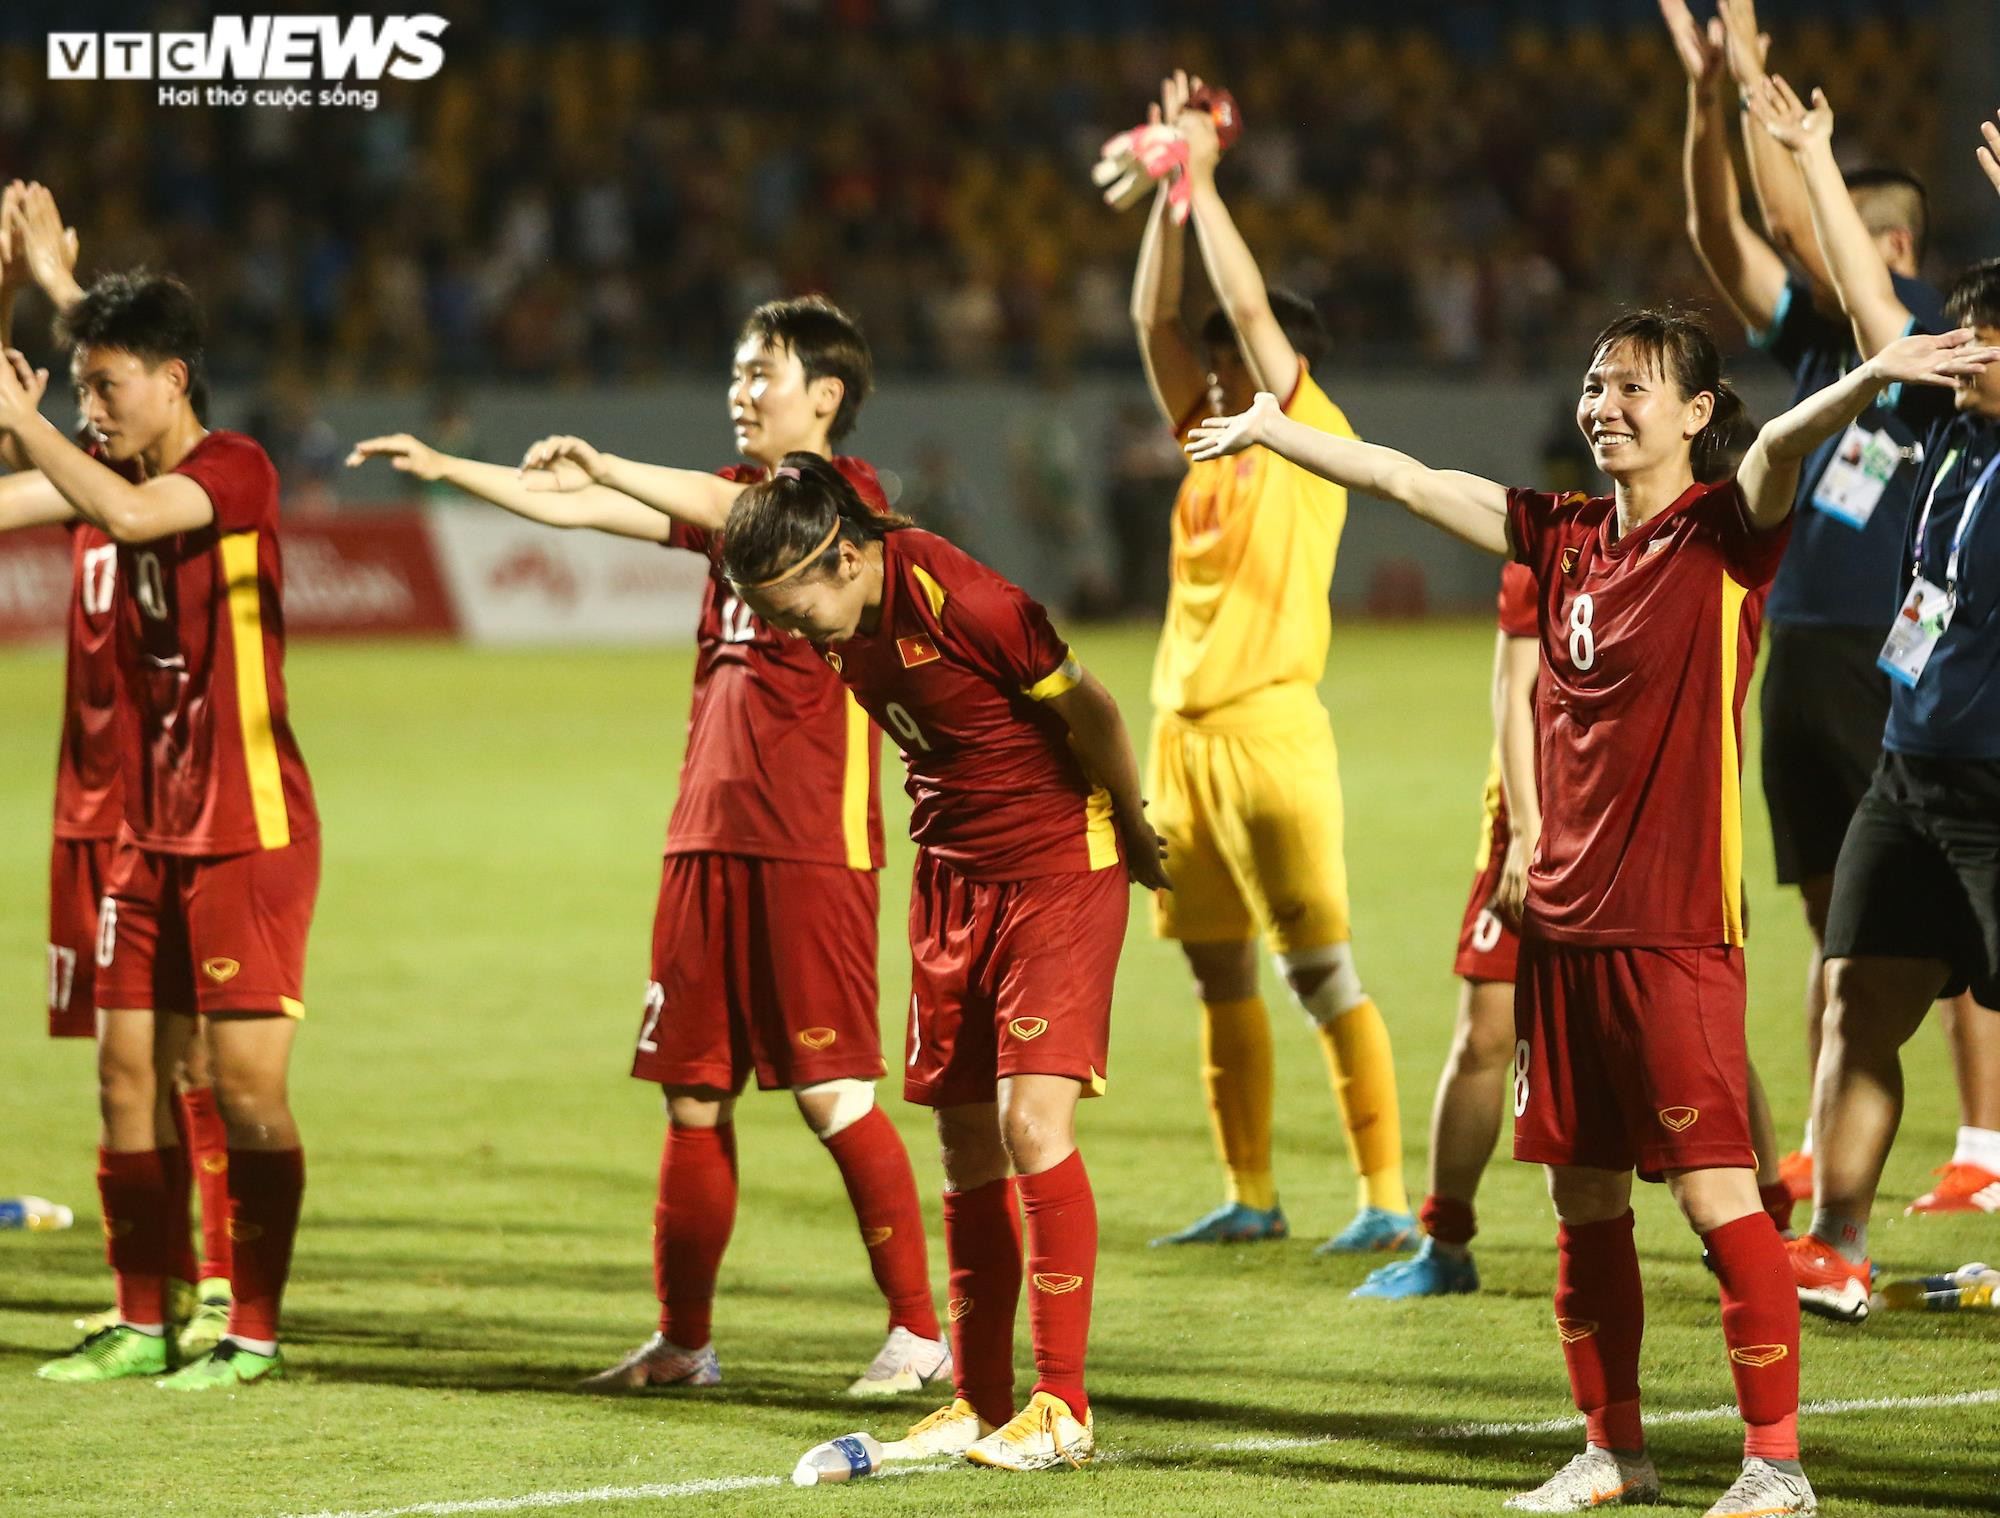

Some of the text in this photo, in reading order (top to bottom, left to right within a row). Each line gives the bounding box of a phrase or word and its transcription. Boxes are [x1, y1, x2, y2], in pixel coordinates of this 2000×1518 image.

[1569, 593, 1594, 671] 8
[886, 702, 932, 751] 9
[1514, 1038, 1531, 1118] 8
